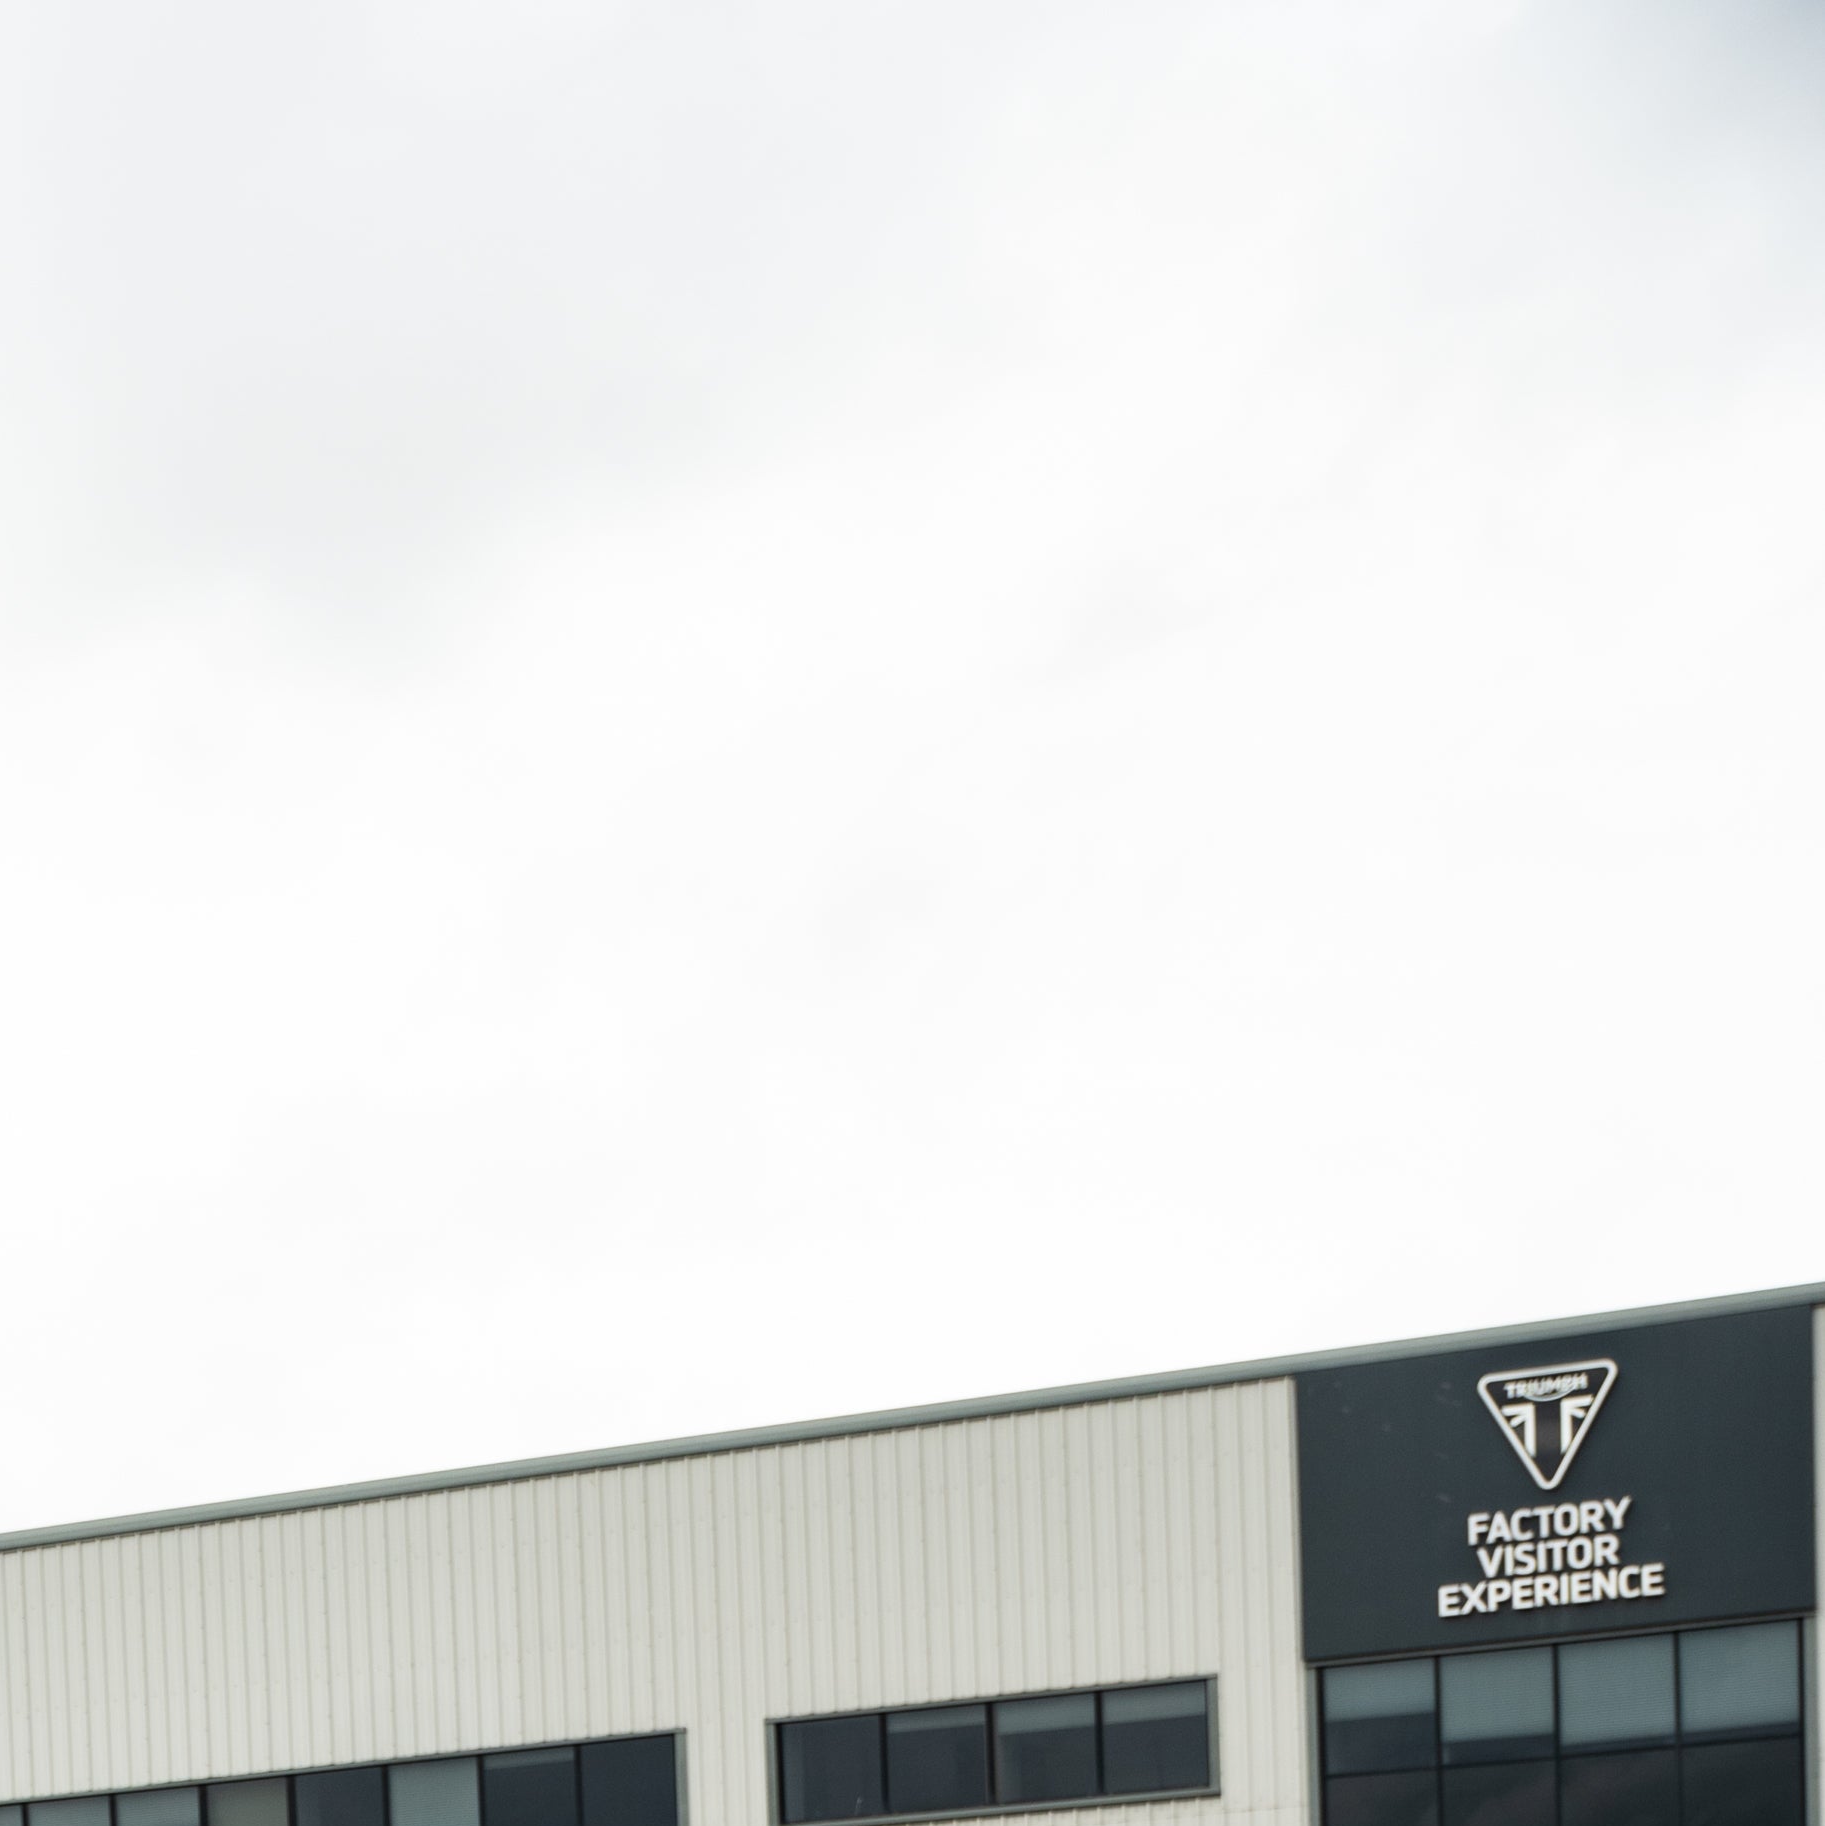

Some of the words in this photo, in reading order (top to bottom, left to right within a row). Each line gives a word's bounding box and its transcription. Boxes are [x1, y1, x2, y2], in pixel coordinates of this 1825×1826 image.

[1504, 1372, 1589, 1399] TRIUMPH
[1467, 1495, 1632, 1546] FACTORY
[1477, 1534, 1621, 1578] VISITOR
[1438, 1562, 1666, 1618] EXPERIENCE
